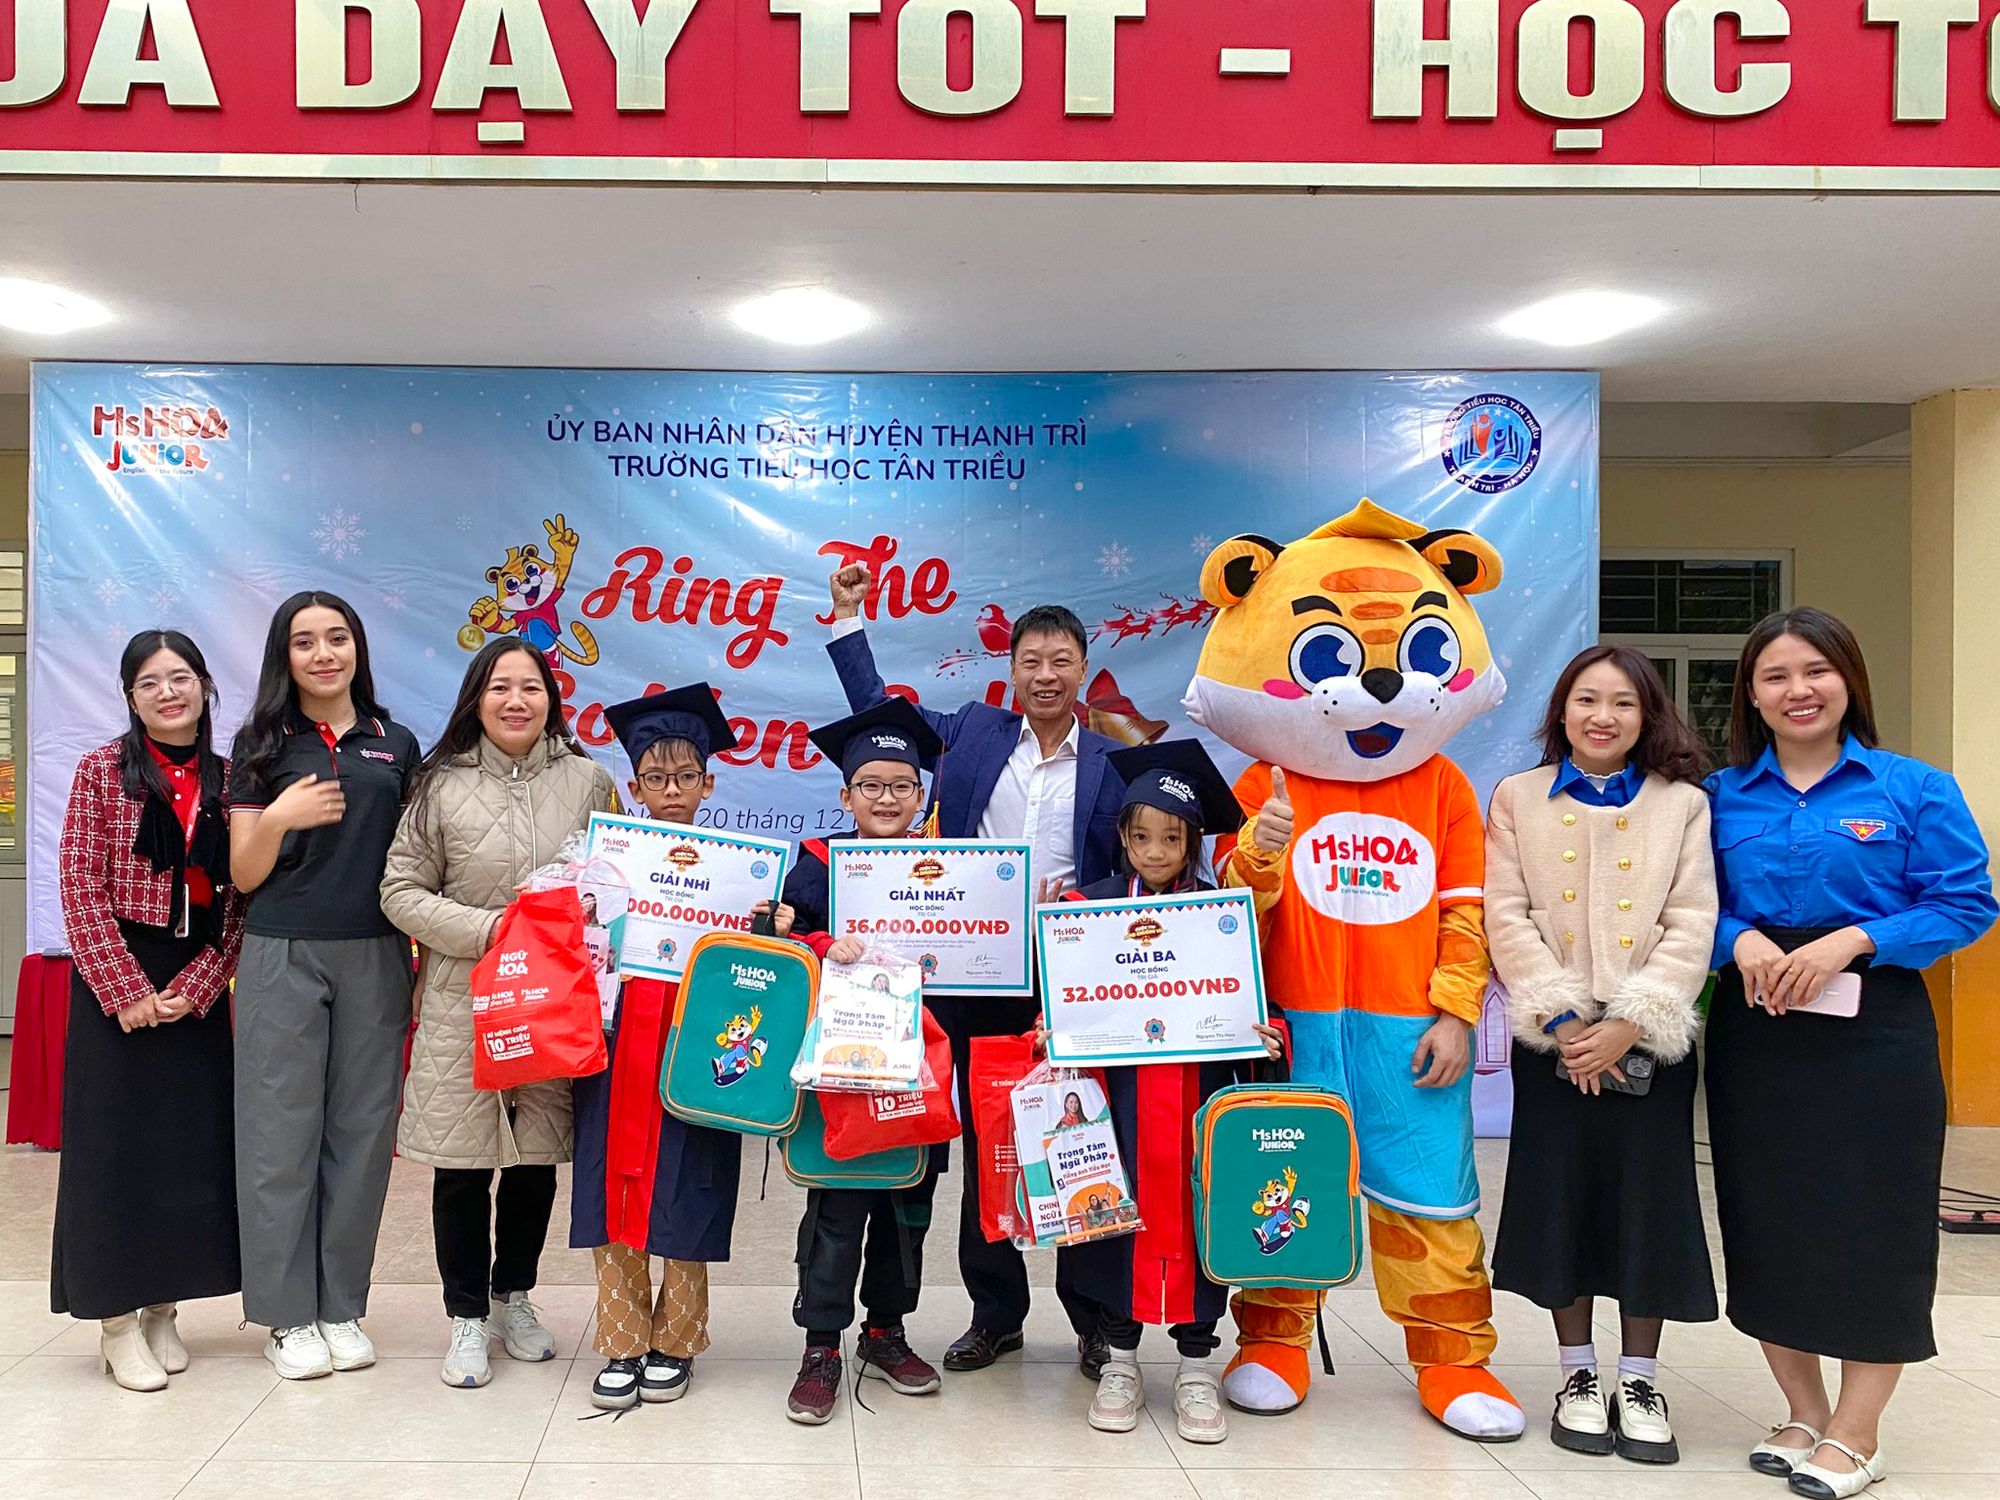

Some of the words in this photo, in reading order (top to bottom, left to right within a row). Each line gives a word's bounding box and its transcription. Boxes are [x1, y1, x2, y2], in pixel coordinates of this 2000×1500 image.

[295, 0, 701, 145] DẠY
[1370, 0, 1792, 151] HỌC
[547, 413, 585, 441] ỦY
[594, 420, 653, 444] BAN
[663, 417, 745, 445] NHÂN
[756, 420, 817, 447] DÂN
[827, 418, 922, 453] HUYỆN
[931, 424, 1034, 447] THANH
[1042, 418, 1086, 446] TRÌ
[608, 450, 728, 479] TRƯỜNG
[810, 458, 870, 486] HỌC
[879, 452, 934, 480] TÂN
[943, 449, 1025, 480] TRIỀU
[582, 546, 789, 670] Ring
[815, 534, 958, 622] The
[698, 808, 728, 829] 20
[735, 806, 805, 834] tháng
[814, 808, 844, 829] 12
[650, 871, 680, 887] GIẢI
[684, 877, 710, 892] NHÌ
[889, 886, 920, 901] GIẢI
[924, 887, 966, 901] NHẤT
[1115, 948, 1148, 965] GIẢI
[1153, 950, 1176, 963] BA
[487, 1038, 505, 1053] 10
[875, 1096, 895, 1112] 10
[1057, 1147, 1084, 1160] Trọng
[1086, 1142, 1106, 1152] Tâm
[1060, 1158, 1080, 1170] Ngữ
[1083, 1151, 1108, 1163] Pháp
